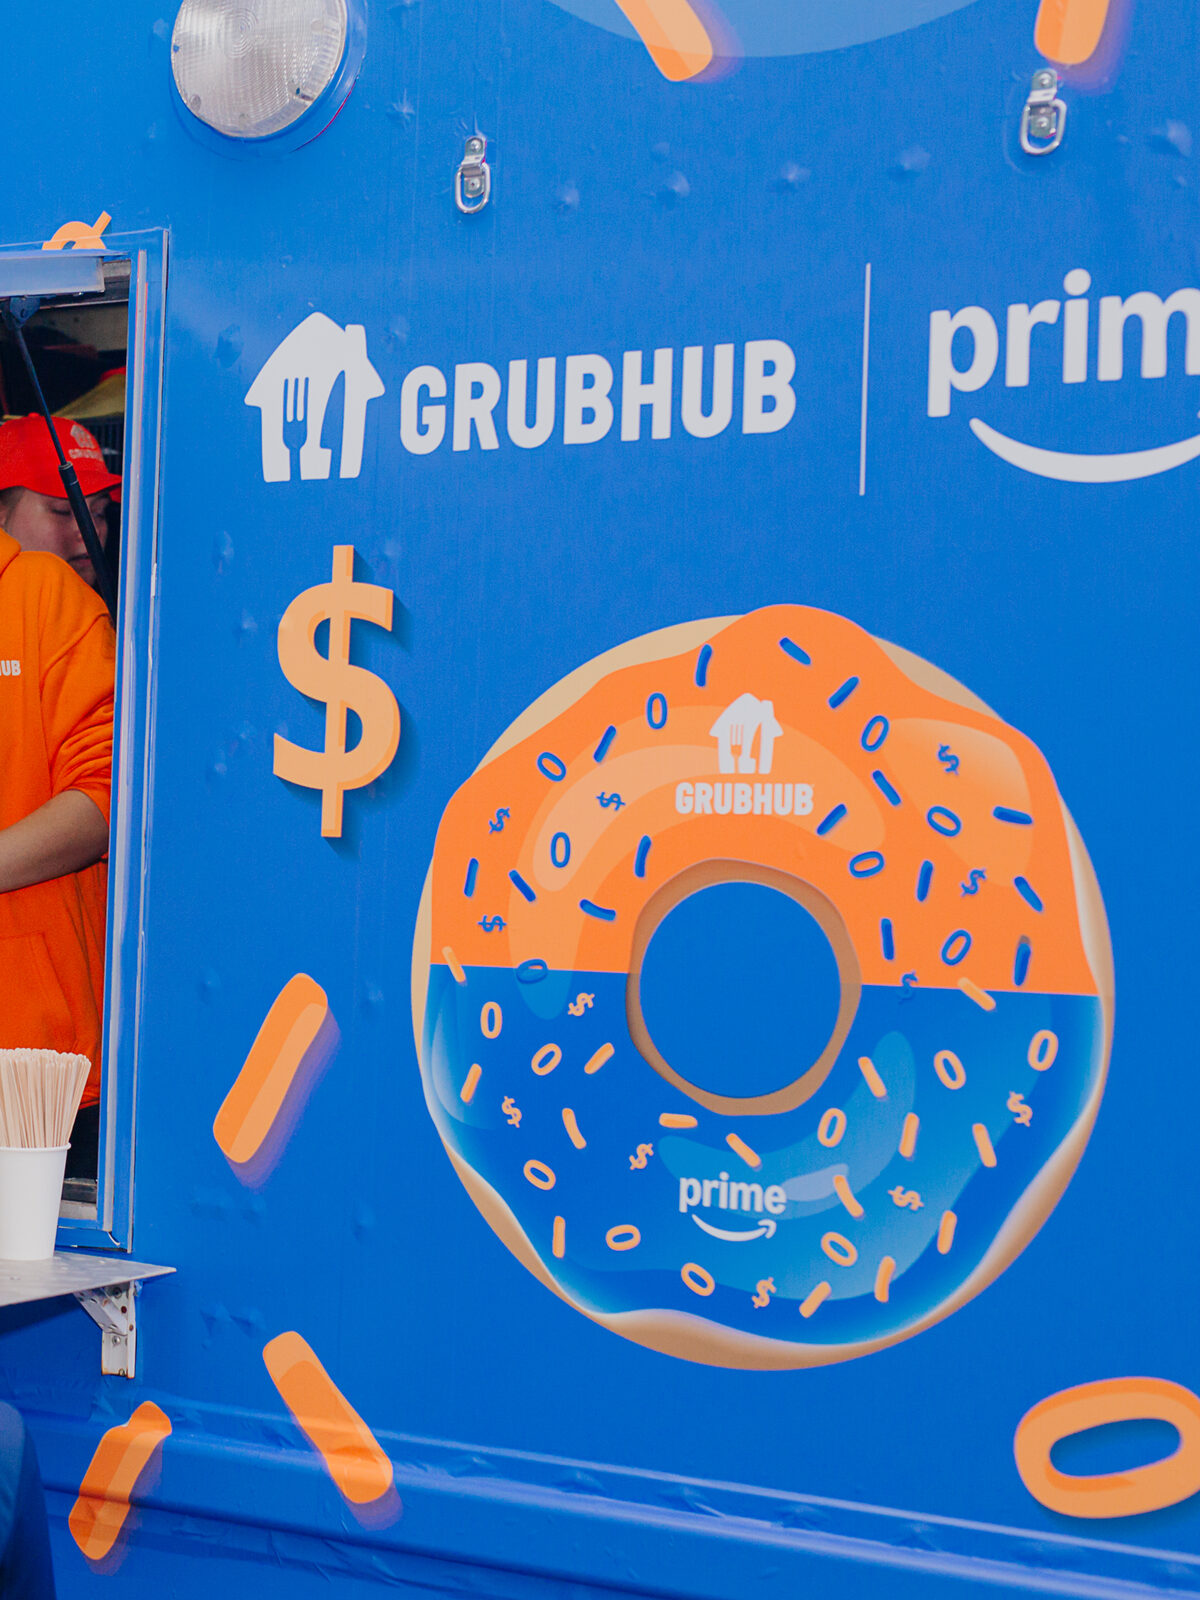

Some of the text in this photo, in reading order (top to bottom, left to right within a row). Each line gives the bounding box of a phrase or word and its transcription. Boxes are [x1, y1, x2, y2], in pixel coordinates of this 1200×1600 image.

[400, 338, 797, 456] GRUBHUB
[926, 268, 1200, 418] prim
[274, 545, 401, 838] $
[675, 781, 815, 816] GRUBHUB
[679, 1171, 787, 1215] prime
